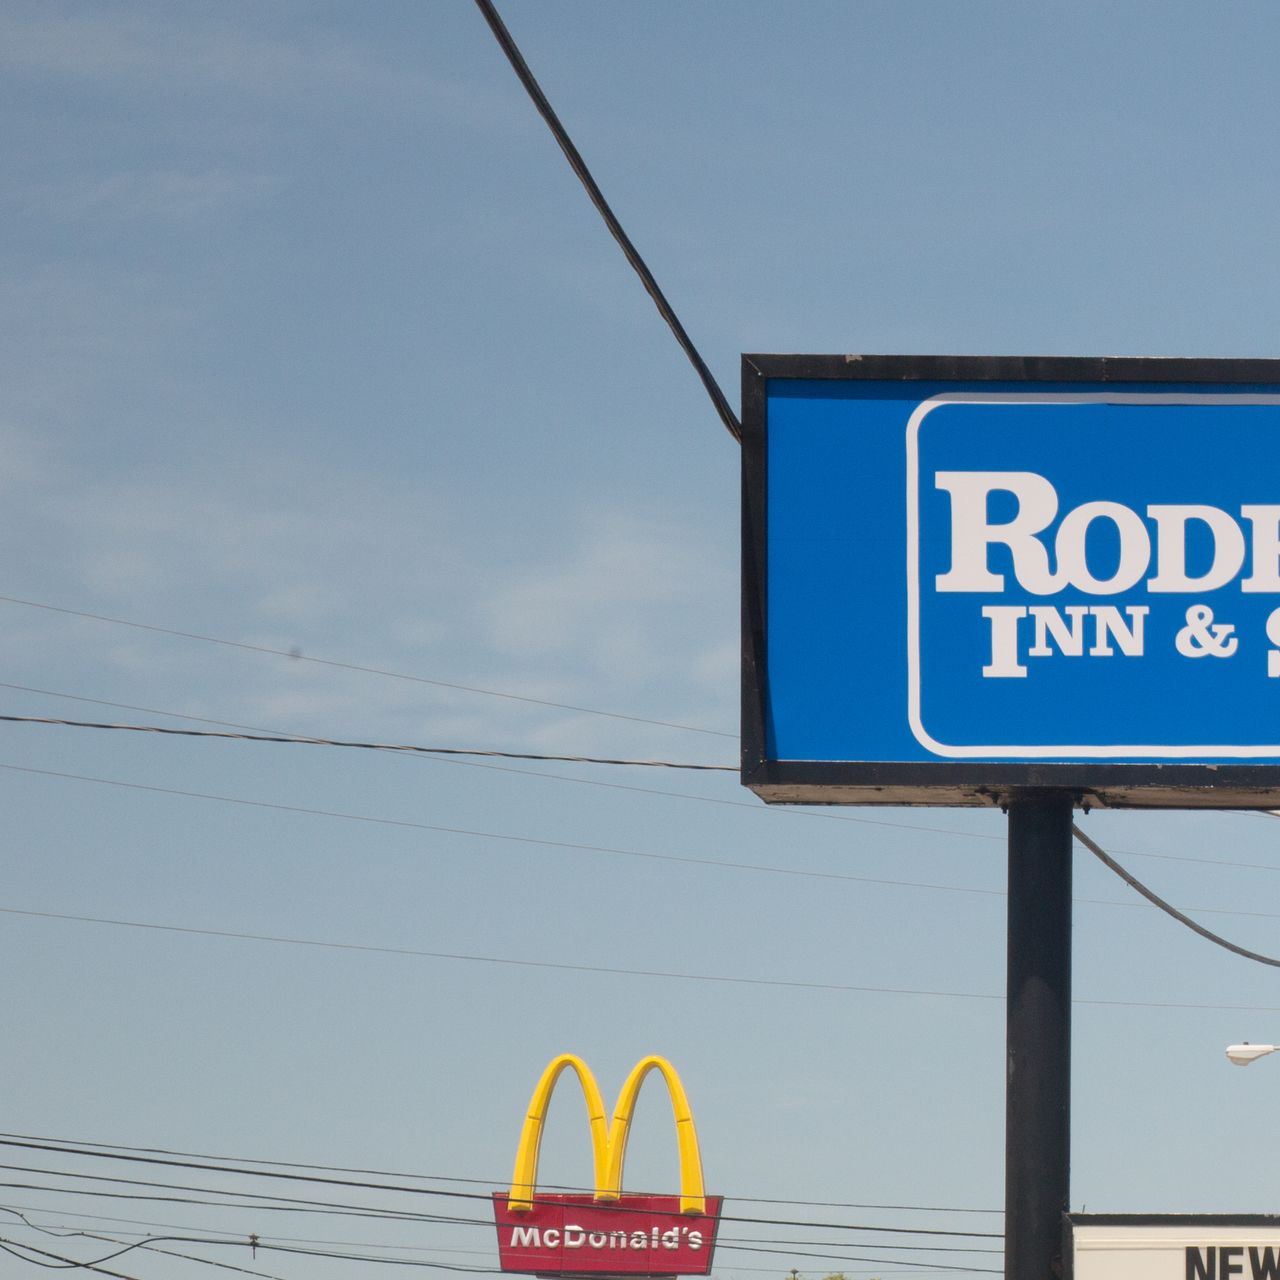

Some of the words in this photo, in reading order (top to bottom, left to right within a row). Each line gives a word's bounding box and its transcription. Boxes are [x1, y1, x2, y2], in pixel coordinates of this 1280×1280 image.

[982, 606, 1149, 678] INN
[1175, 606, 1239, 658] &
[510, 1225, 703, 1250] McDonald's
